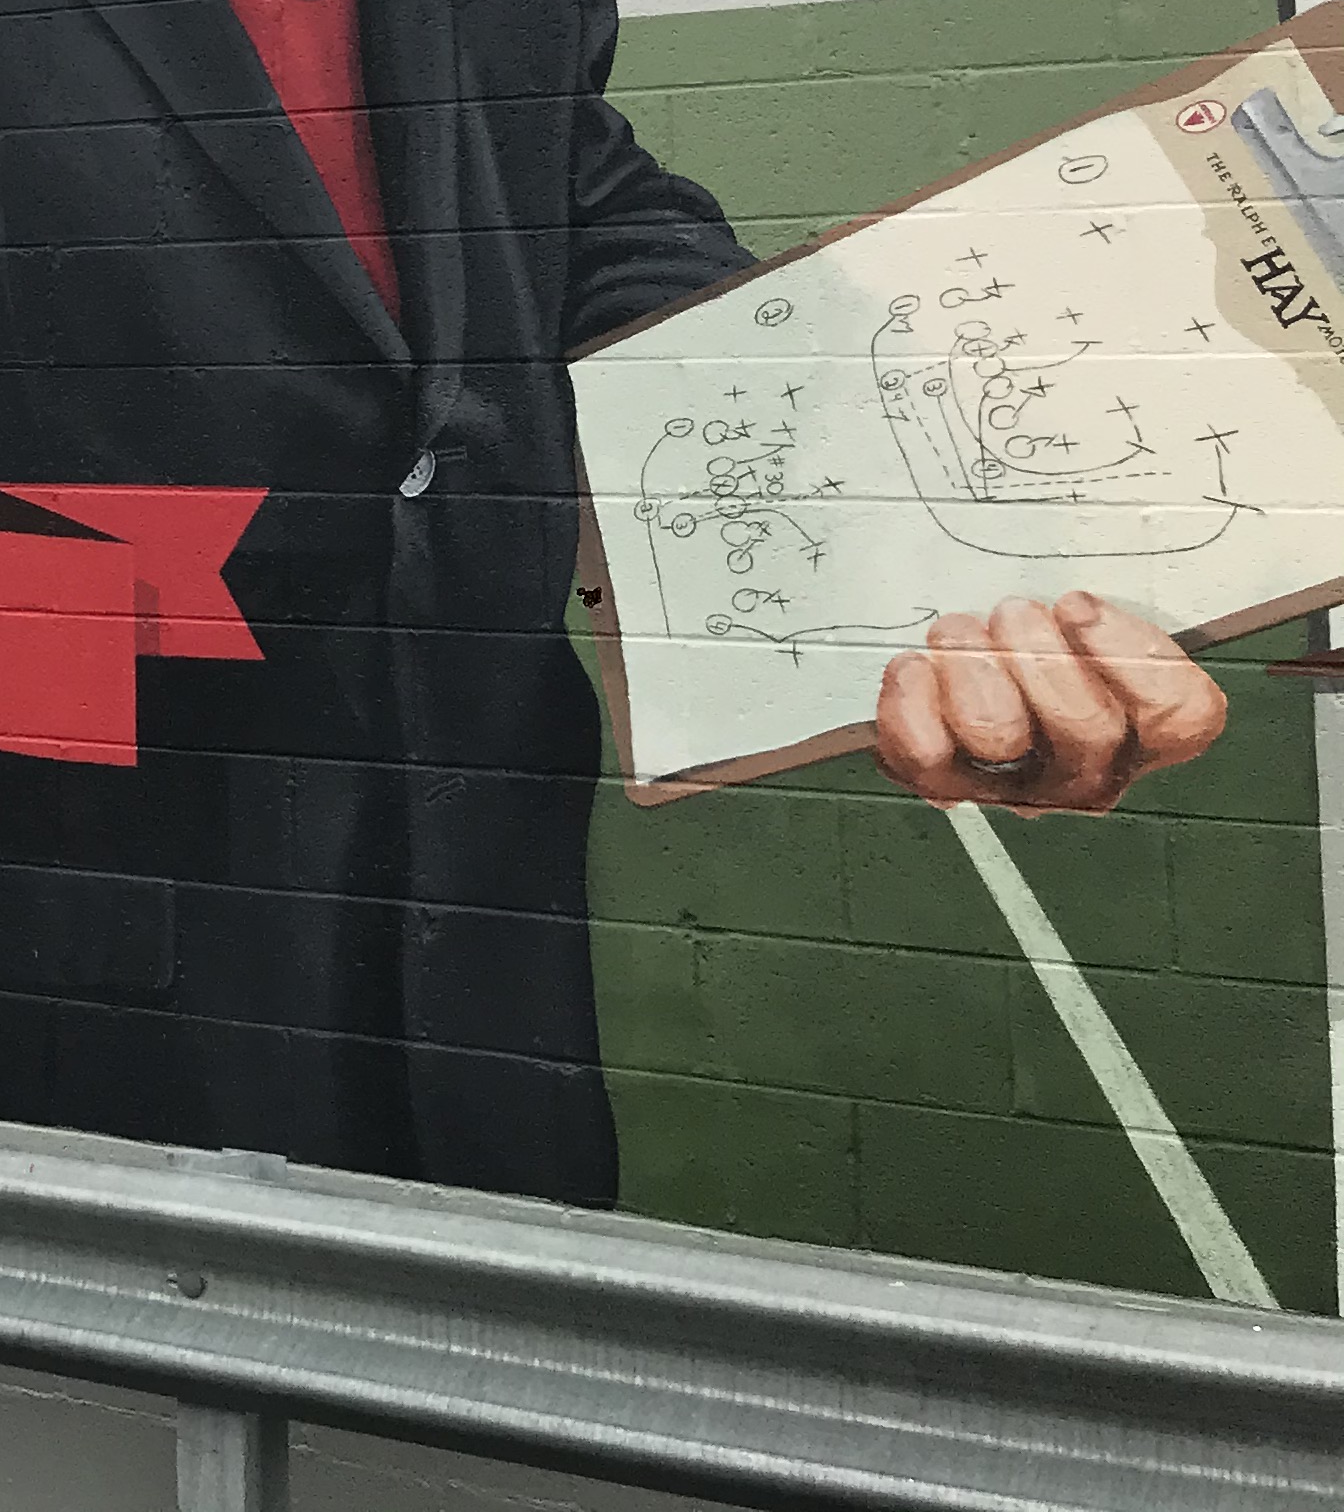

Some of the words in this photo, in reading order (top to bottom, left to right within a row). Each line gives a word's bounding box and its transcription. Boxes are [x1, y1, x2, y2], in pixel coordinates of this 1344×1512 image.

[1205, 151, 1234, 184] THE
[1226, 182, 1268, 236] RALPH
[1239, 245, 1330, 329] HAY
